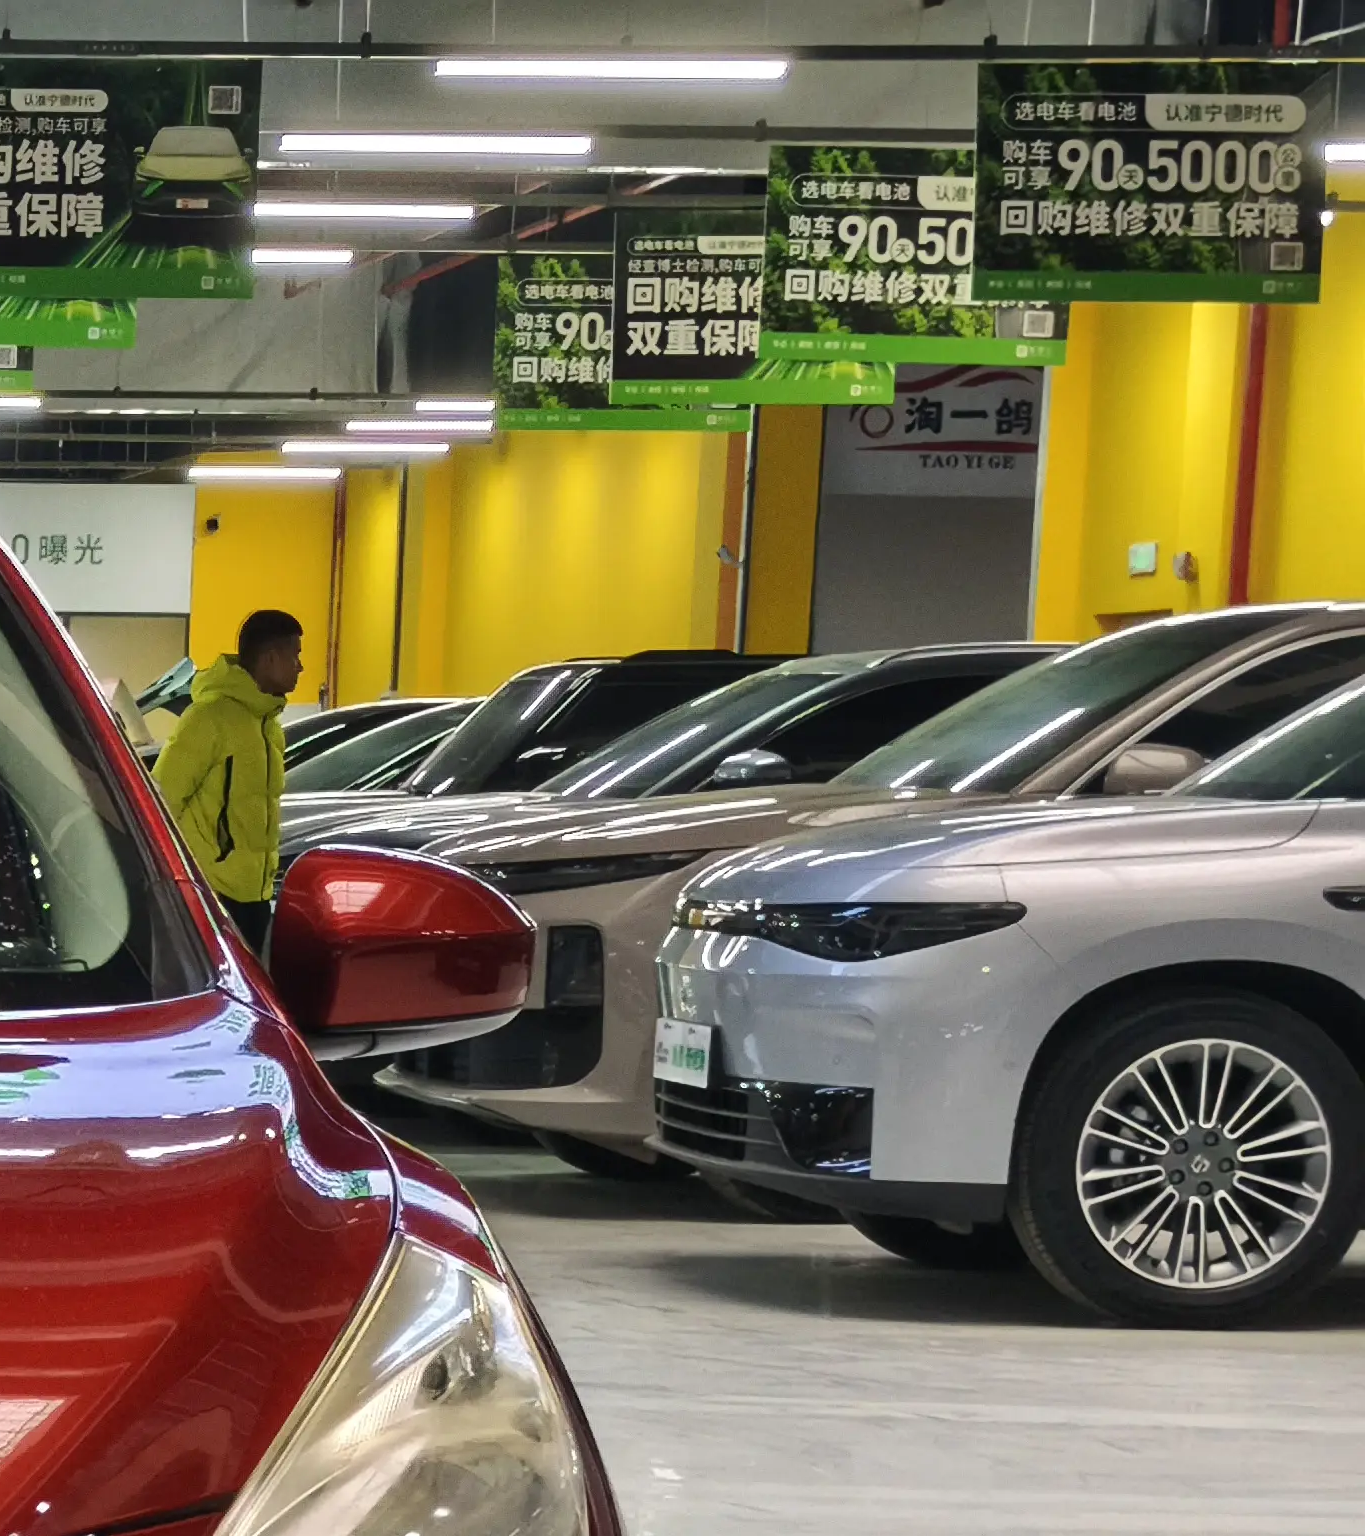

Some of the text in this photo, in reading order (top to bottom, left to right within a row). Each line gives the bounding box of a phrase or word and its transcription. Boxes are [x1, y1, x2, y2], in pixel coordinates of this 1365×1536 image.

[1016, 102, 1284, 123] 选电车看电池 认准宁德时代
[1003, 140, 1053, 164] 购车
[1002, 167, 1052, 190] 可享
[801, 181, 973, 202] 选电车看电池 认准
[789, 215, 835, 237] 购车
[1000, 199, 1299, 238] 回购维修双重保障
[789, 239, 834, 260] 可享
[784, 269, 1047, 308] 回购维修双重
[515, 313, 553, 330] 购车
[514, 332, 553, 350] 可享
[905, 397, 1033, 436] 淘一鸽
[920, 454, 959, 469] TAO
[988, 454, 1016, 470] GE
